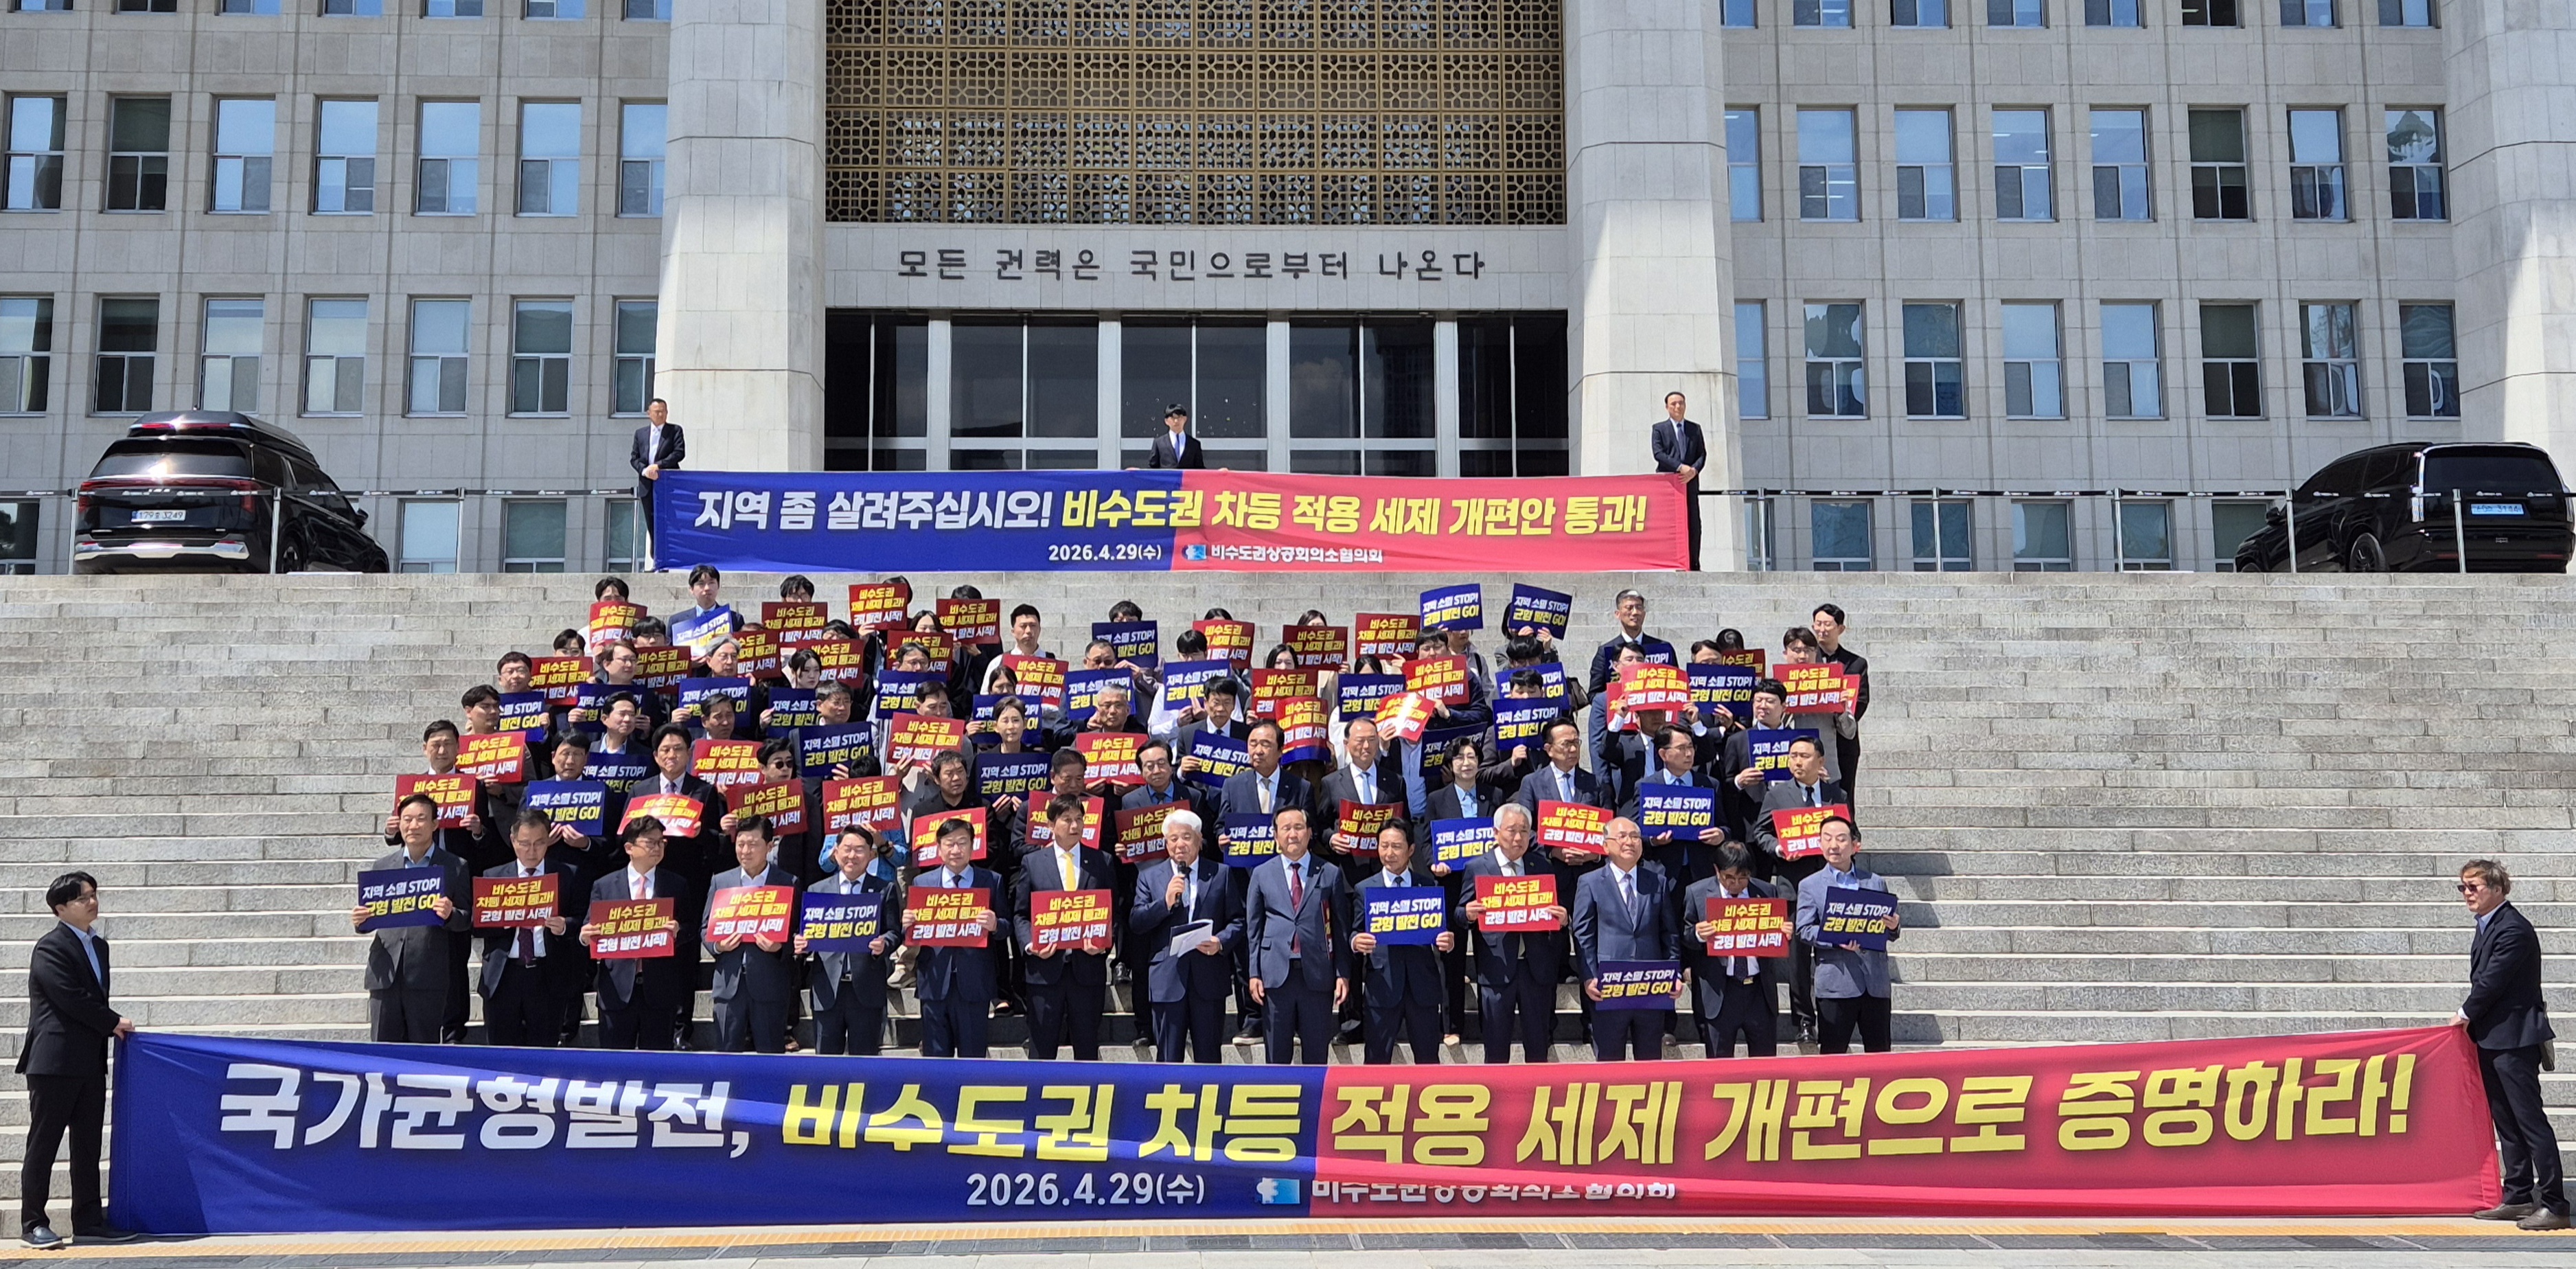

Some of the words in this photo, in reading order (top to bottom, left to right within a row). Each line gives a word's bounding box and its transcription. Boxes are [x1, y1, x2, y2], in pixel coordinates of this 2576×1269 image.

[899, 250, 967, 280] 모든
[996, 250, 1101, 280] 권력은
[1130, 250, 1348, 280] 국민으로부터
[1379, 250, 1485, 280] 나온다
[694, 490, 770, 529] 지역
[779, 490, 816, 529] 좀
[827, 490, 1053, 529] 살려주십시오!
[1062, 490, 1201, 528] 비수도권
[1211, 492, 1282, 528] 차등
[1291, 495, 1361, 534] 적용
[1369, 497, 1440, 535] 세제
[1449, 497, 1556, 536] 개편안
[1563, 494, 1646, 535] 통과!
[1048, 543, 1162, 562] 2026.4.29(수)
[1210, 543, 1383, 563] 비수도권상공회의소협의회
[363, 885, 384, 899] 지역
[409, 878, 440, 893] STOP!
[492, 881, 542, 895] 비수도권
[1494, 880, 1540, 895] 비수도권
[391, 898, 415, 913] 발전
[730, 891, 777, 905] 비수도권
[926, 893, 974, 906] 비수도권
[1050, 895, 1096, 909] 비수도권
[504, 908, 525, 920] 발전
[527, 906, 551, 919] 시작!
[609, 904, 658, 919] 비수도권
[803, 908, 824, 920] 지역
[846, 904, 877, 919] STOP!
[1369, 901, 1389, 915] 지역
[1412, 898, 1442, 911] STOP!
[1725, 904, 1771, 917] 비수도권
[1827, 902, 1845, 915] 지역
[1863, 905, 1891, 917] STOP!
[1396, 915, 1419, 930] 발전
[1421, 913, 1442, 928] GO!
[1507, 908, 1528, 924] 발전
[737, 920, 757, 933] 발전
[759, 918, 783, 932] 시작!
[829, 922, 853, 937] 발전
[856, 920, 877, 936] GO!
[936, 924, 956, 938] 발전
[958, 922, 982, 937] 시작!
[1061, 927, 1081, 941] 발전
[1083, 924, 1106, 939] 시작!
[1847, 919, 1867, 933] 발전
[1867, 921, 1886, 934] GO!
[620, 936, 641, 950] 발전
[643, 933, 667, 947] 시작!
[1736, 934, 1757, 948] 발전
[1758, 933, 1782, 946] 시작!
[1602, 972, 1622, 983] 지역
[1645, 969, 1675, 981] STOP!
[1626, 983, 1650, 996] 발전
[1652, 981, 1673, 994] GO!
[220, 1063, 750, 1159] 국가균형발전,
[782, 1082, 1115, 1162] 비수도권
[1138, 1082, 1303, 1162] 차등
[1332, 1084, 1491, 1166] 적용
[1517, 1082, 1683, 1165] 세제
[1705, 1076, 2033, 1161] 개편으로
[2058, 1053, 2416, 1151] 증명하라!
[966, 1172, 1205, 1207] 2026.4.29(수)
